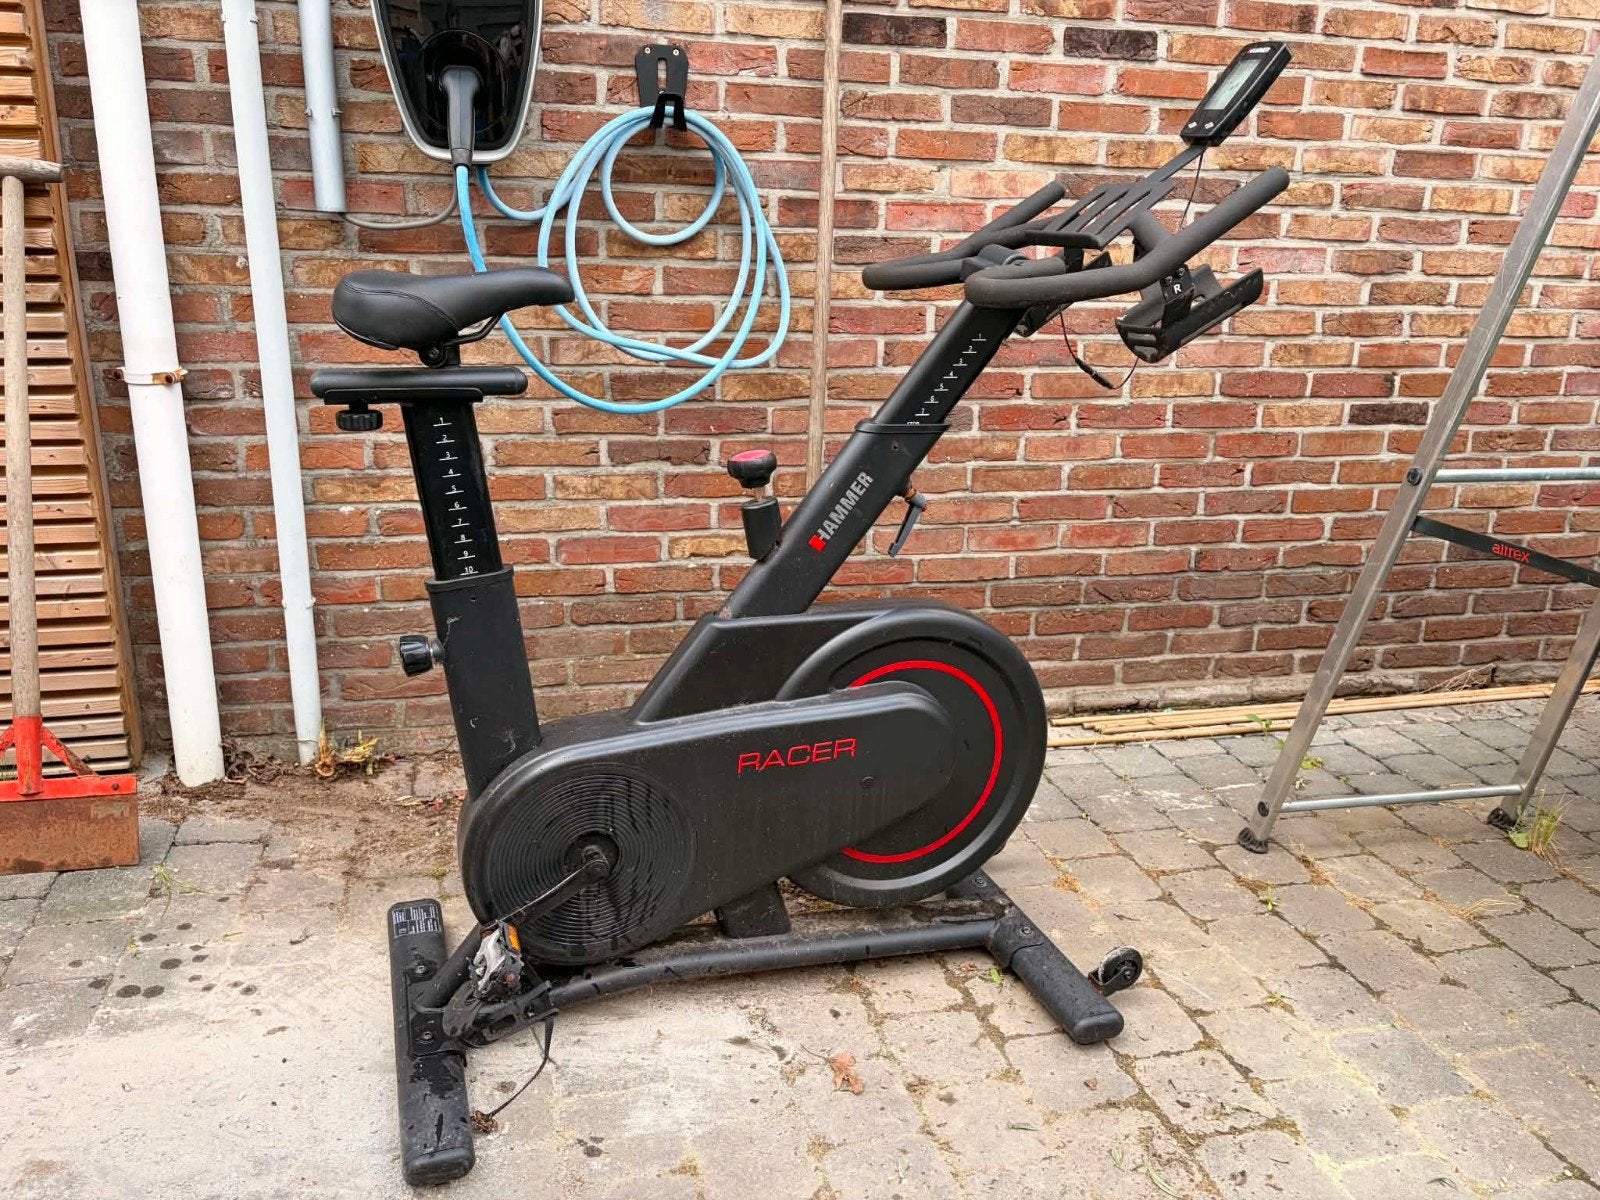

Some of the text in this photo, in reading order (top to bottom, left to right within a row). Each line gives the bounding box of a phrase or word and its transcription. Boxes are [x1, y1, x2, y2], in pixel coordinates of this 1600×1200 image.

[1173, 283, 1182, 294] R
[808, 472, 874, 552] HAMMER
[1492, 543, 1530, 563] altrex
[737, 738, 857, 775] RACER
